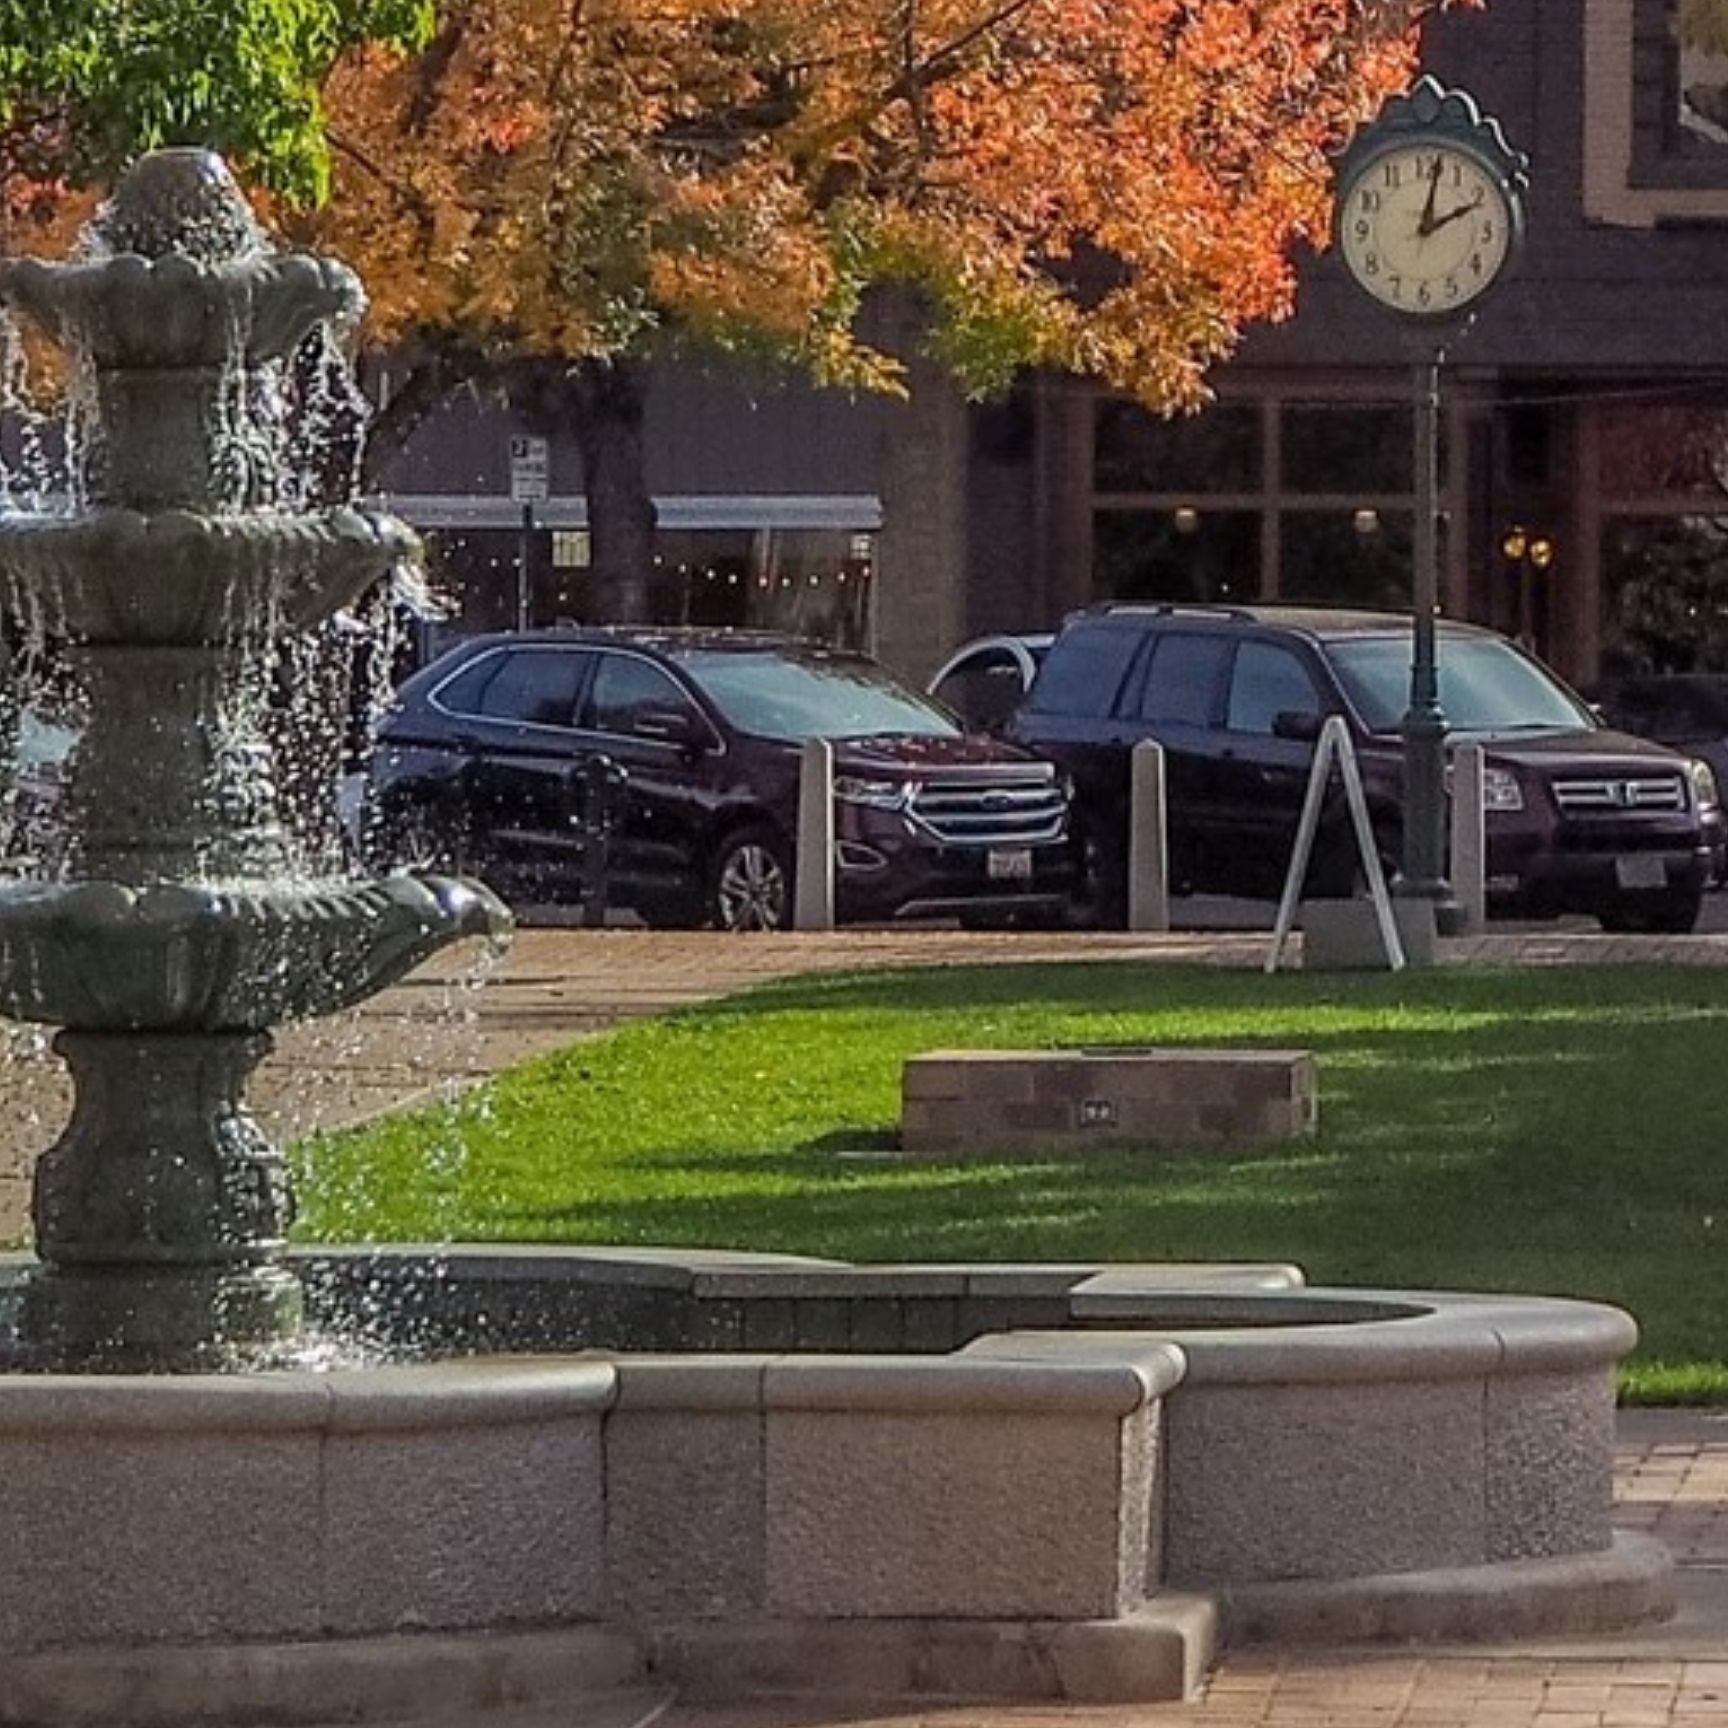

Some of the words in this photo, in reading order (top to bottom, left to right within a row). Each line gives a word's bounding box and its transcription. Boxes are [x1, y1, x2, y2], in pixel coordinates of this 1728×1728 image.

[1385, 164, 1400, 188] 11
[1454, 164, 1463, 188] 1
[1361, 190, 1380, 213] 10
[1471, 186, 1485, 207] 2
[1355, 220, 1370, 242] 9
[1480, 220, 1493, 245] 3
[1366, 252, 1380, 275] 8
[1469, 253, 1482, 276] 4
[1388, 275, 1401, 299] 7
[1419, 280, 1431, 306] 6
[1445, 276, 1459, 298] 5
